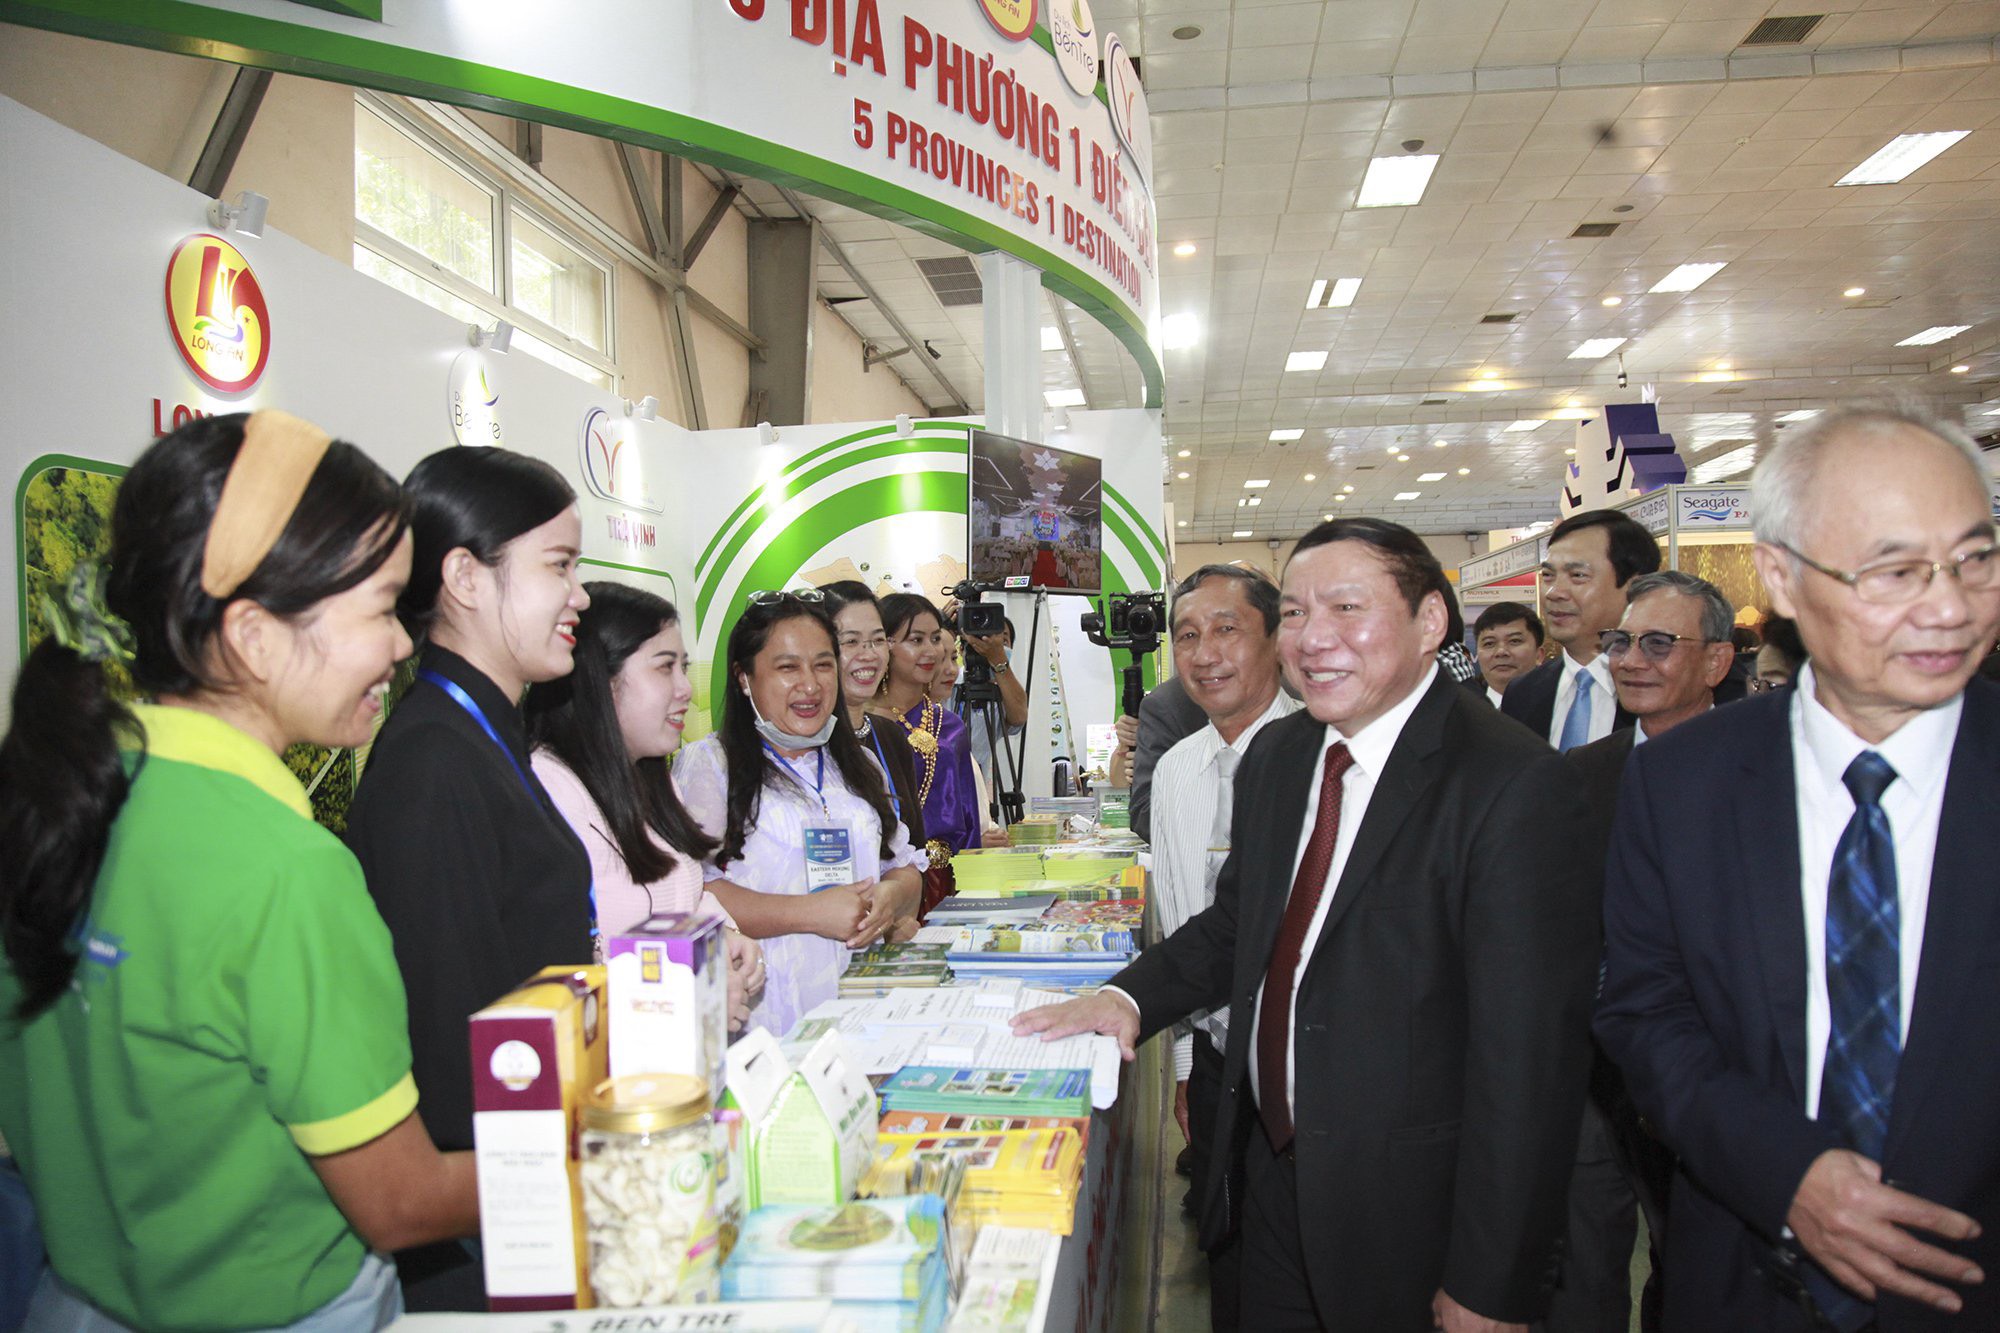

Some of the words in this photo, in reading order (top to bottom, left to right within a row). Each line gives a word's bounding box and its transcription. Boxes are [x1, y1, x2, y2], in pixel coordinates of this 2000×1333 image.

[903, 14, 1060, 173] PHƯƠNG
[1069, 126, 1082, 188] 1
[853, 97, 874, 150] 5
[886, 110, 1040, 226] PROVINCES
[1046, 194, 1057, 236] 1
[1063, 202, 1143, 307] DESTINATION
[191, 334, 223, 355] LONG
[1683, 496, 1740, 511] Seagate
